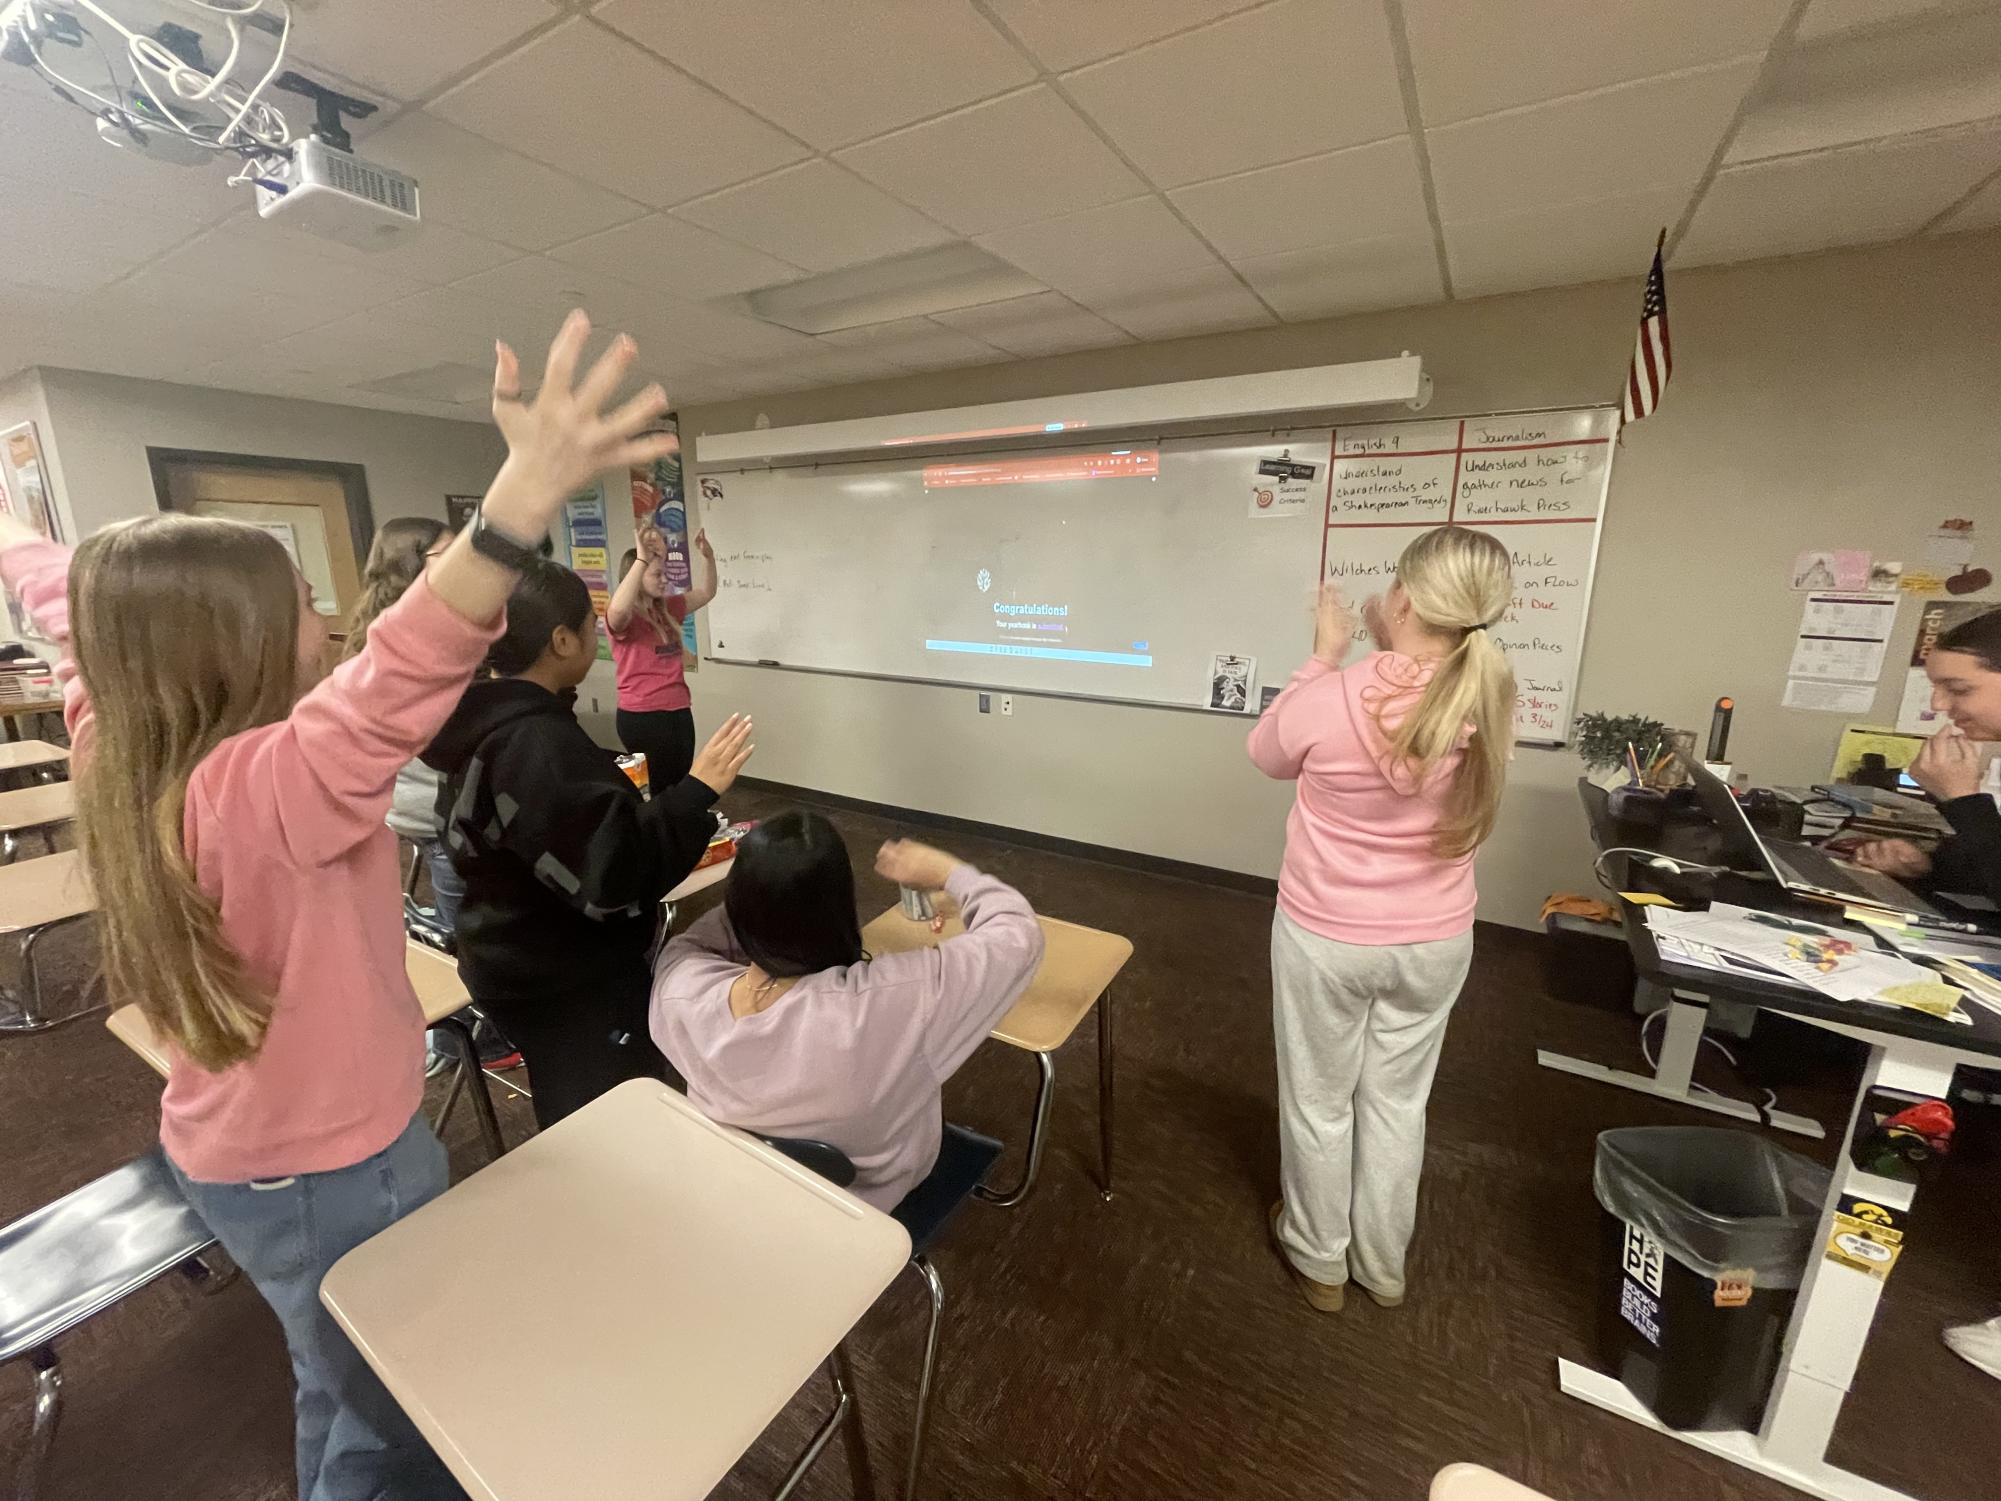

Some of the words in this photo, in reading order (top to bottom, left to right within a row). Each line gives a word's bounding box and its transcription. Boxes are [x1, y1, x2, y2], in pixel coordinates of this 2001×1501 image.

[1475, 427, 1547, 443] Journalism
[1343, 436, 1386, 454] English
[1391, 436, 1400, 449] 9
[1465, 457, 1527, 472] Understand
[1537, 454, 1567, 467] how
[1340, 464, 1402, 480] Understand
[1422, 478, 1439, 490] of
[1462, 480, 1502, 498] gather
[1509, 478, 1548, 489] news
[1331, 503, 1338, 512] a
[1537, 498, 1570, 512] Press
[1512, 552, 1558, 567] Article
[1524, 581, 1539, 590] on
[993, 602, 1068, 616] Congratulations!
[1531, 598, 1559, 611] Due
[1533, 637, 1562, 653] Pieces
[1622, 1287, 1651, 1318] BUILD
[1623, 1277, 1659, 1314] BOOKS
[1621, 1296, 1660, 1337] BETTER
